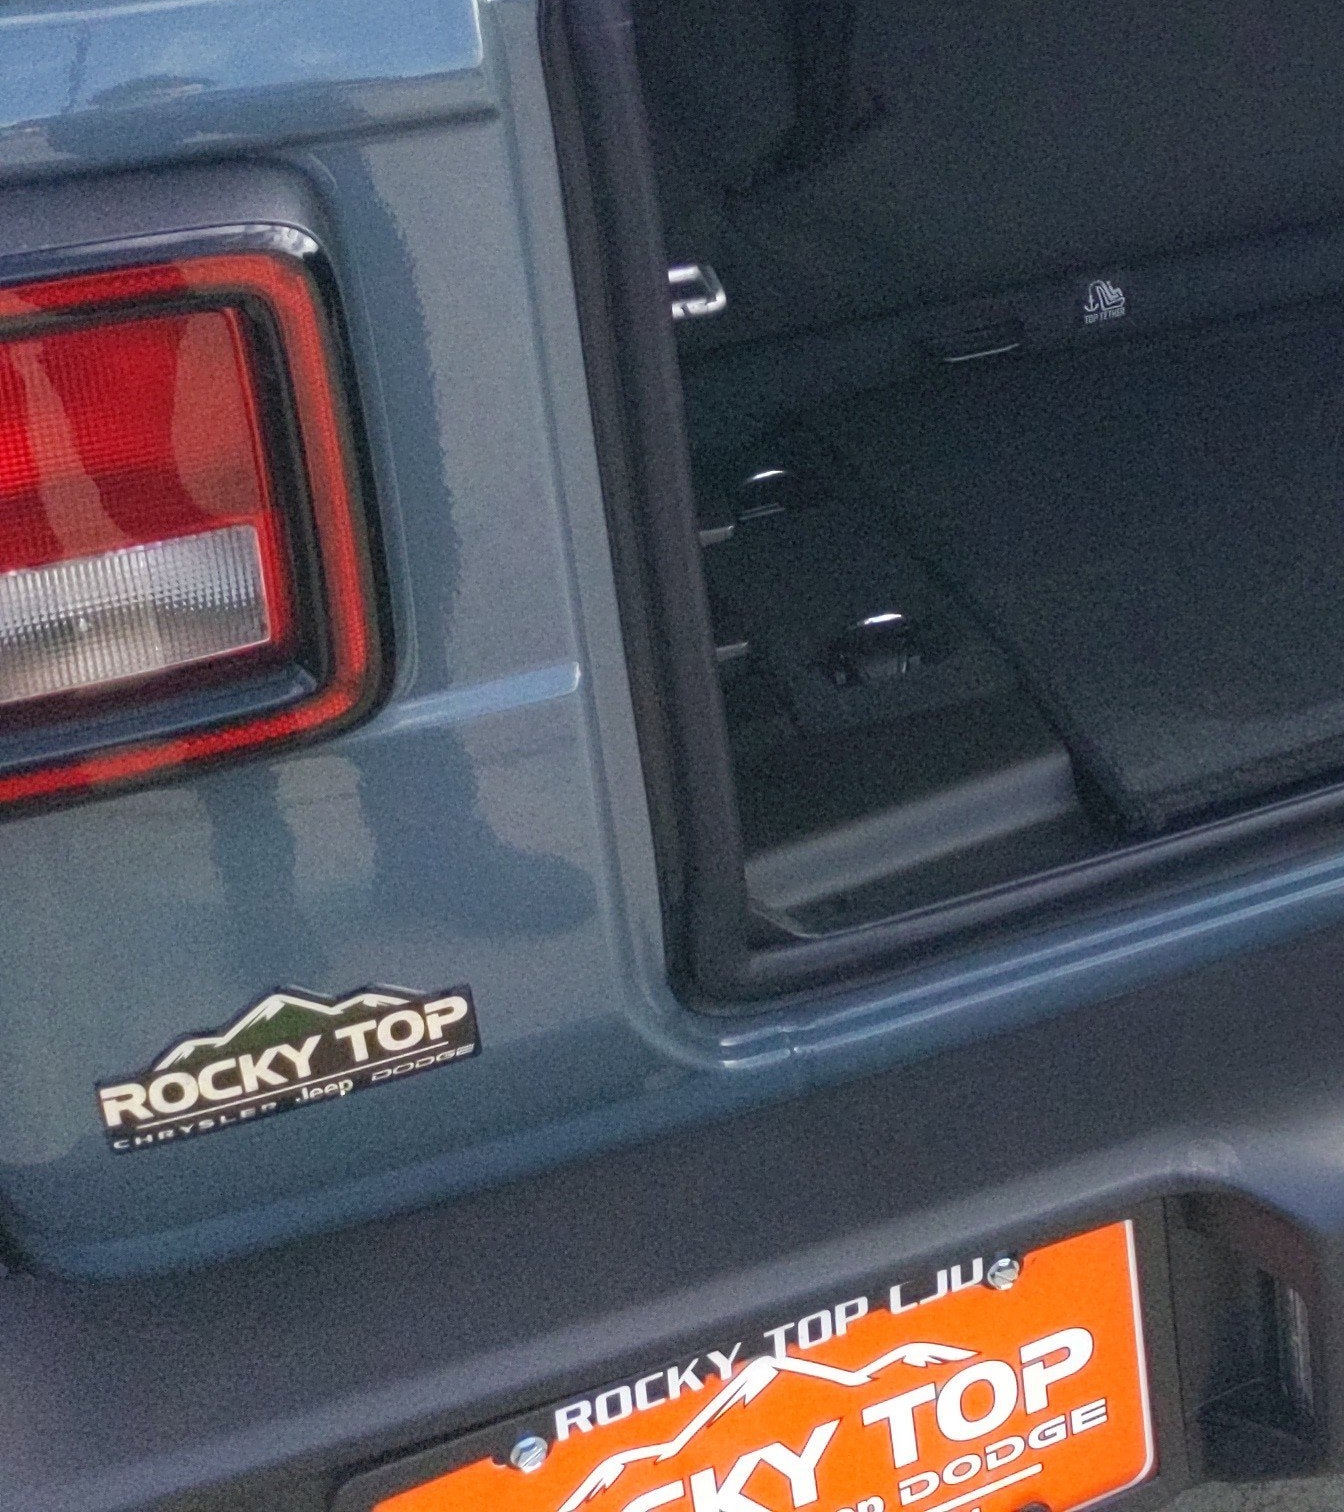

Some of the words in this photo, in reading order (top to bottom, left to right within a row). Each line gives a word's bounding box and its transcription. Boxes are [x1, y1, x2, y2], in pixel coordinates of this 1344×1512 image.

[100, 1034, 326, 1127] ROCKY
[333, 994, 468, 1062] TOP
[112, 1100, 278, 1149] CHRYSLER
[295, 1076, 354, 1103] Jeep
[371, 1042, 475, 1083] DODGE
[554, 1341, 742, 1442] ROCKY
[763, 1295, 868, 1361] TOP
[861, 1326, 1094, 1470] TOP
[897, 1397, 1109, 1506] DODGE
